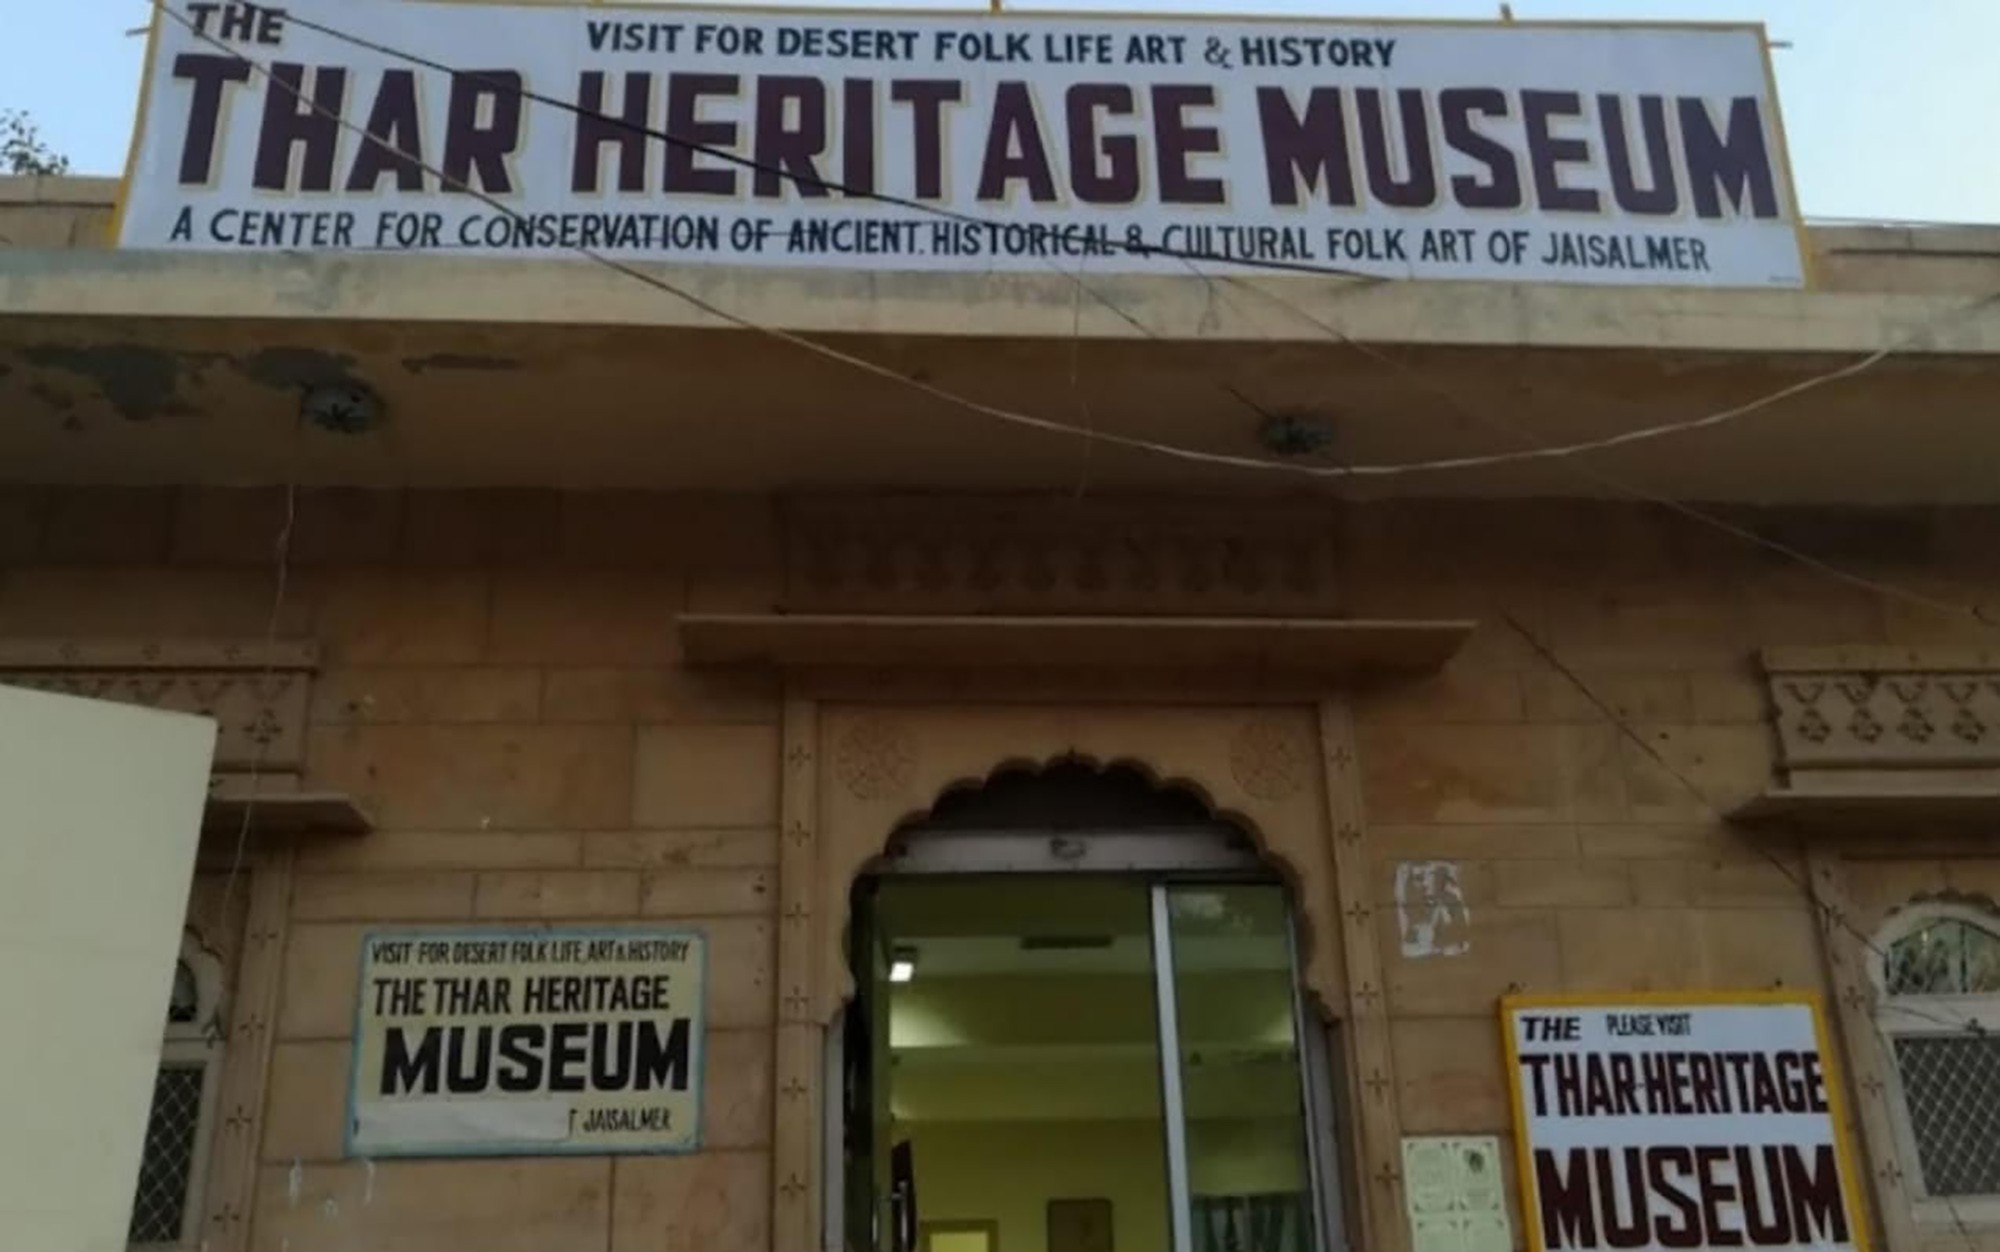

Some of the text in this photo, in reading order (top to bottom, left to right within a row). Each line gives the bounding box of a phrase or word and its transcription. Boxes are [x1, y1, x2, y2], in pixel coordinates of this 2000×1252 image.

[187, 3, 286, 44] THE
[587, 21, 1396, 70] VISIT FOR DESERT FOLK LIFE ART & HISTORY
[172, 53, 1780, 219] THAR HERITAGE MUSEUM
[170, 205, 193, 242] A
[209, 208, 356, 247] CENTER
[376, 211, 443, 248] FOR
[458, 213, 720, 251] CONSERVATION
[729, 217, 773, 253] OF
[931, 221, 1116, 257] HISTORICAL
[1125, 223, 1150, 259] &
[1161, 224, 1316, 261] CULTURAL
[1327, 228, 1406, 263] FOLK
[1420, 229, 1476, 264] ART
[1488, 231, 1530, 267] OF
[1541, 234, 1711, 272] JAISALMER
[372, 941, 413, 965] VISIT
[418, 941, 449, 964] FOR
[452, 941, 507, 964] DESERT
[511, 940, 547, 964] FOLK
[627, 939, 690, 963] HISTORY
[373, 974, 670, 1016] THE THAR HERITAGE
[1520, 1016, 1582, 1042] THE
[1605, 1012, 1692, 1037] PLEASE VISIT
[380, 1017, 691, 1095] MUSEUM
[582, 1106, 672, 1133] JAISALMER
[1533, 1143, 1850, 1250] MUSEUM
